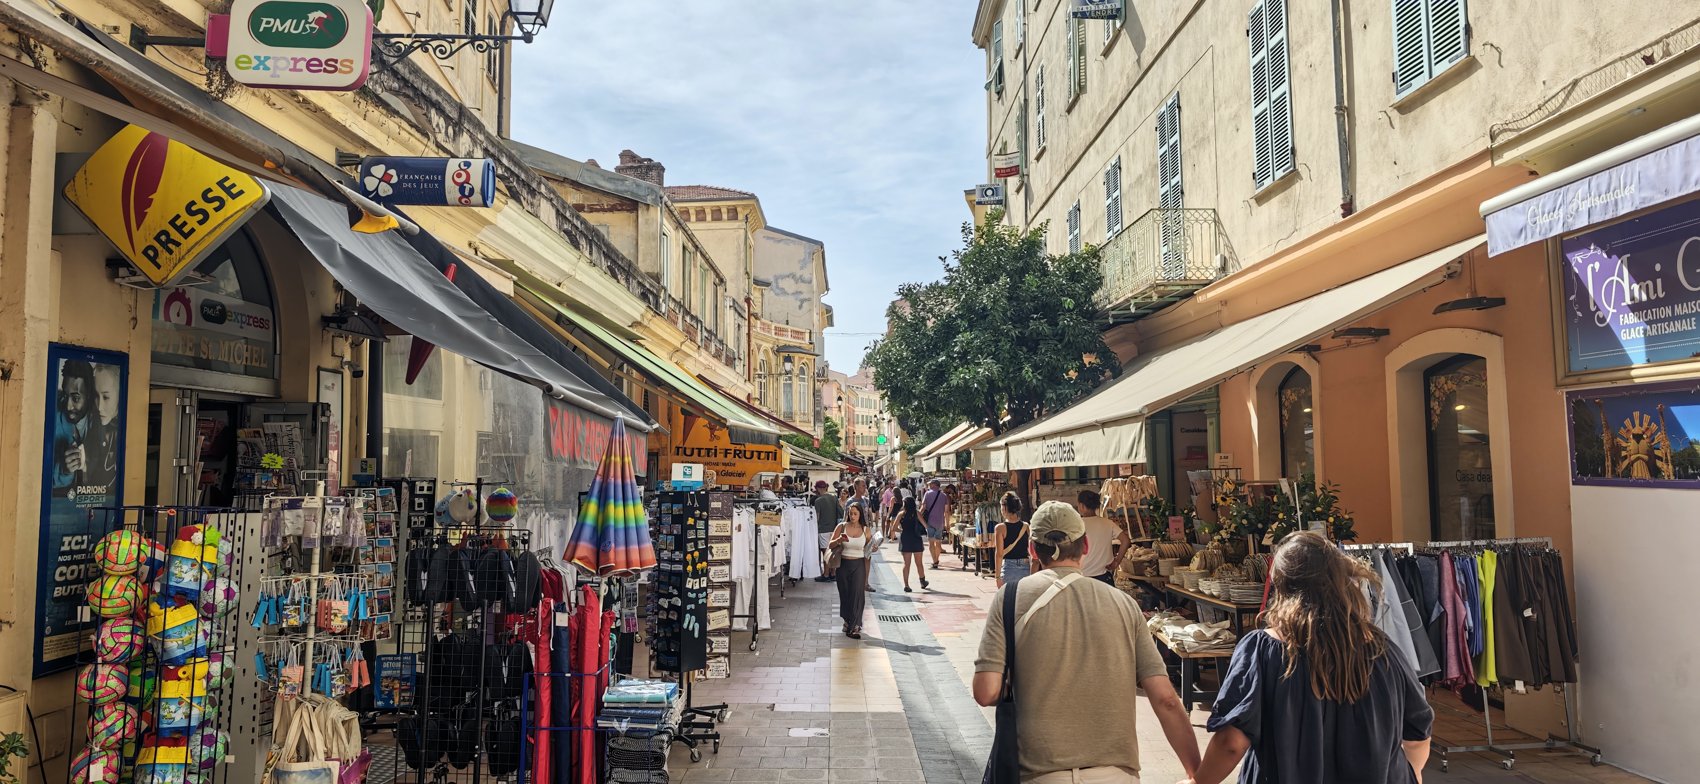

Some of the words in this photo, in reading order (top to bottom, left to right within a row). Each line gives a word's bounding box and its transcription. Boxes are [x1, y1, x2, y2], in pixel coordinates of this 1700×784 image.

[1085, 9, 1117, 17] VENDRE
[259, 17, 306, 34] PMU
[234, 54, 354, 78] express
[1528, 203, 1563, 226] Glaces
[1566, 171, 1636, 220] Artisanales
[141, 176, 246, 270] PRESSE
[227, 309, 270, 330] express
[1620, 306, 1673, 326] FABRICATION
[1620, 326, 1645, 341] GLACE
[1646, 318, 1697, 337] ARTISANALE
[219, 340, 268, 369] MICHEL
[76, 485, 107, 495] PARIONS
[77, 495, 105, 503] SPORT
[55, 564, 99, 582] COTE
